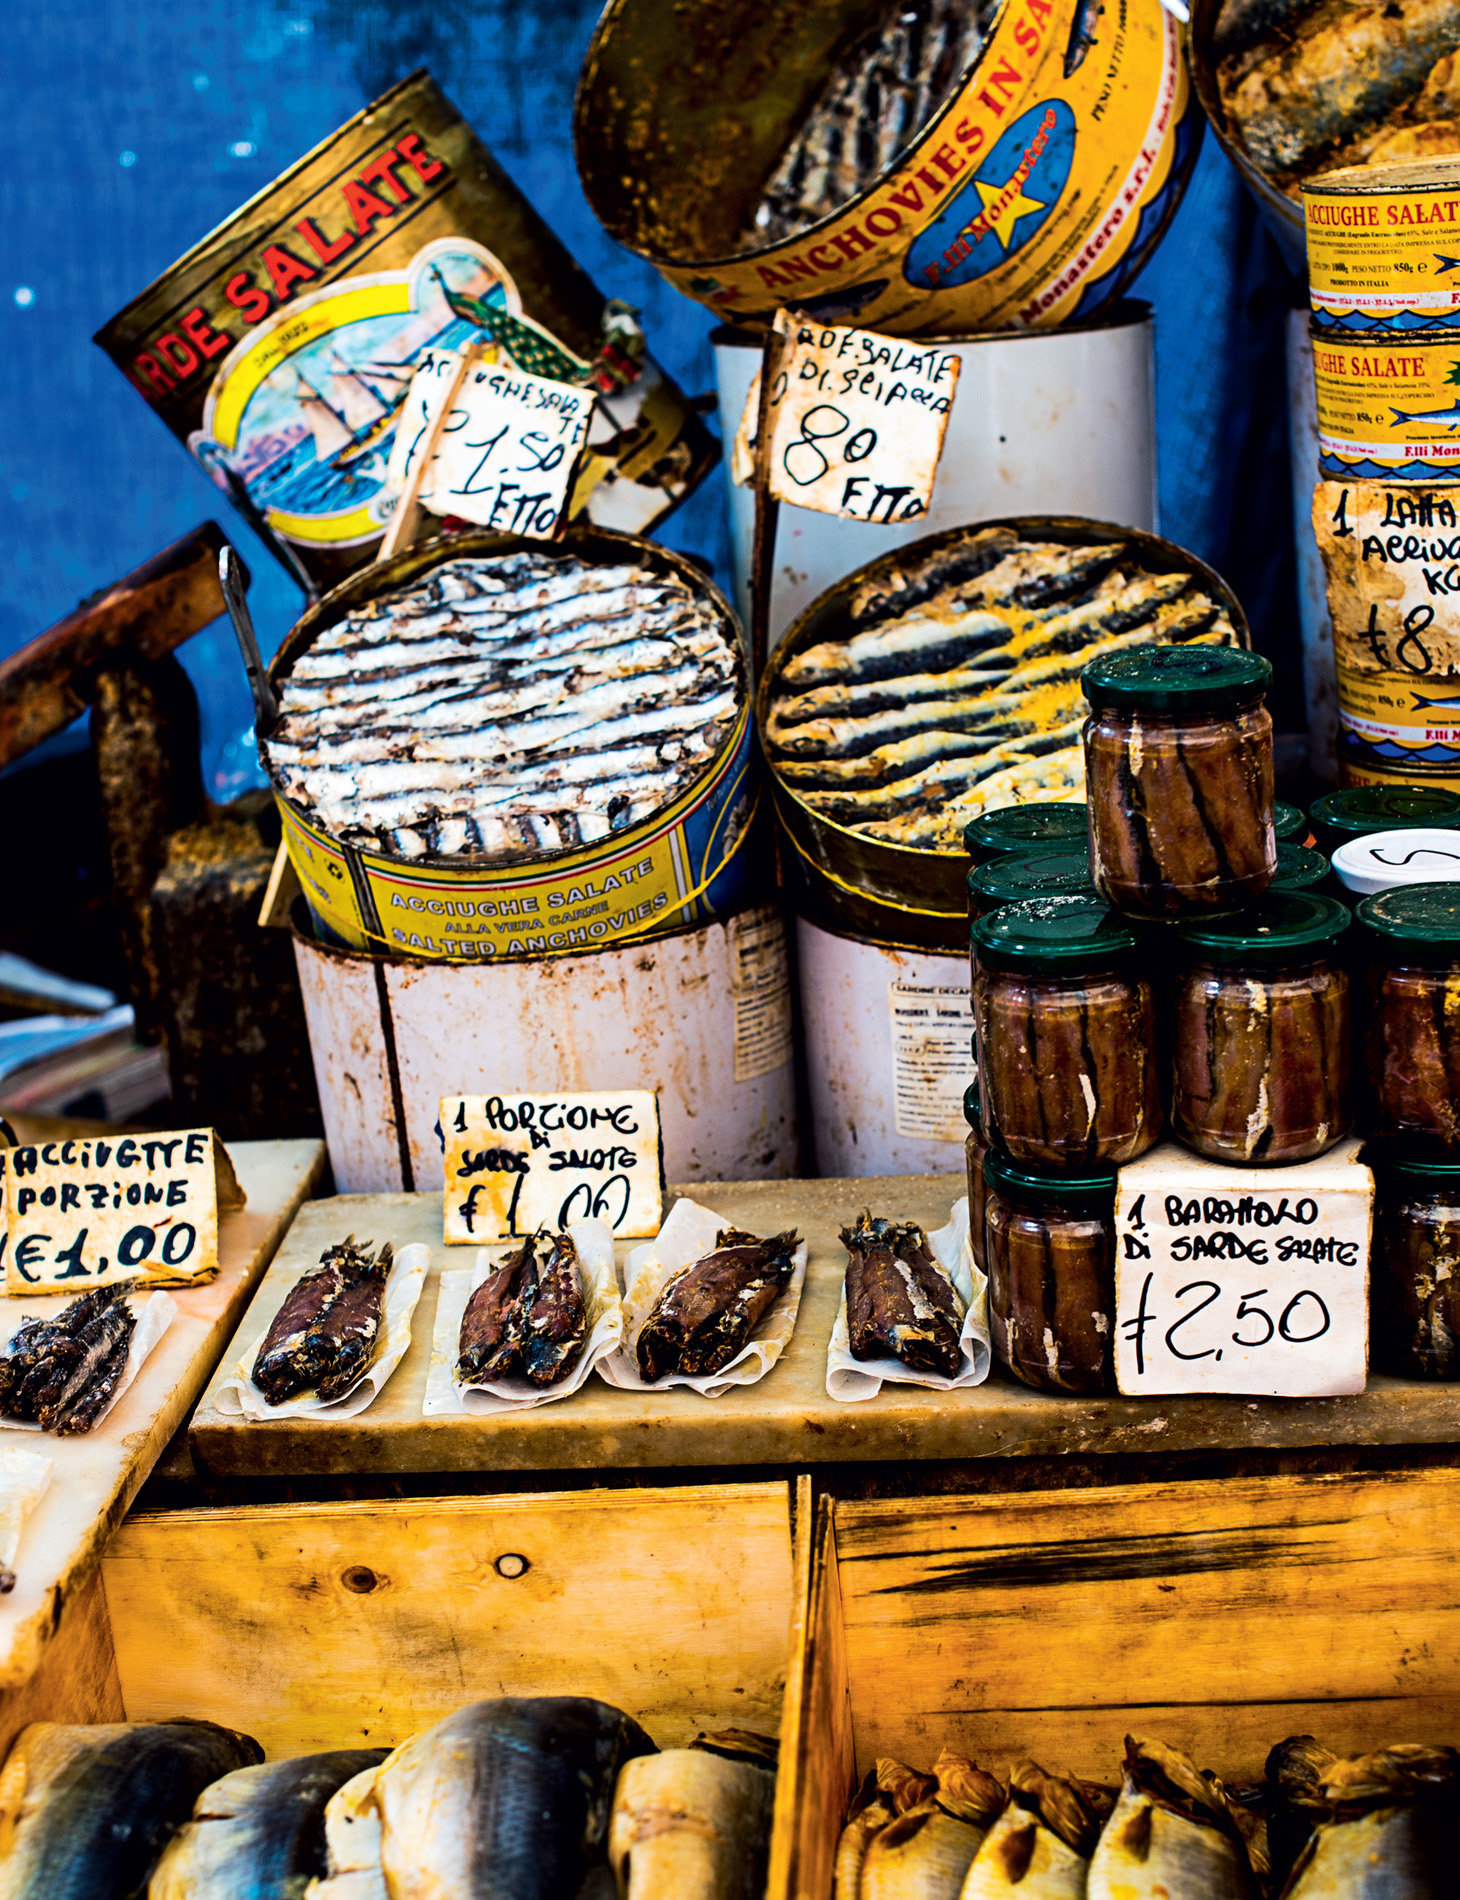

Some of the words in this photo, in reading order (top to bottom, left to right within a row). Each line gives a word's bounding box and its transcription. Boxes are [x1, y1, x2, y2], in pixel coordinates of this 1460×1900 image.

[756, 117, 985, 288] ANCHOVIES
[977, 56, 1023, 119] IN
[968, 108, 1056, 243] Monastero
[225, 133, 444, 324] SALATE
[1308, 204, 1380, 226] ACCIUGHE
[1386, 201, 1460, 226] SALAT
[1018, 208, 1123, 325] Monastero
[1330, 279, 1358, 287] PRODOTTO
[1369, 265, 1391, 273] NETTO
[1394, 262, 1413, 273] 850g
[1351, 357, 1426, 378] SALATE
[1432, 445, 1460, 457] Mon
[489, 482, 557, 534] ETTO
[842, 477, 925, 524] ETTO
[1332, 489, 1354, 537] 1
[1380, 492, 1457, 528] LATTA
[391, 892, 540, 917] ACCIUGHE
[547, 857, 655, 908] SALATE
[392, 927, 496, 957] SALTED
[508, 892, 668, 955] ANCHOVIES
[445, 922, 488, 935] ALLA
[494, 919, 544, 934] VERA
[549, 901, 610, 926] CARNE
[453, 1101, 468, 1133] 1
[18, 1179, 189, 1215] PORZIONE
[1127, 1194, 1146, 1230] 1
[1164, 1195, 1319, 1227] BARATTOLO
[15, 1222, 197, 1283] €1,00
[1170, 1231, 1269, 1265] SARDE
